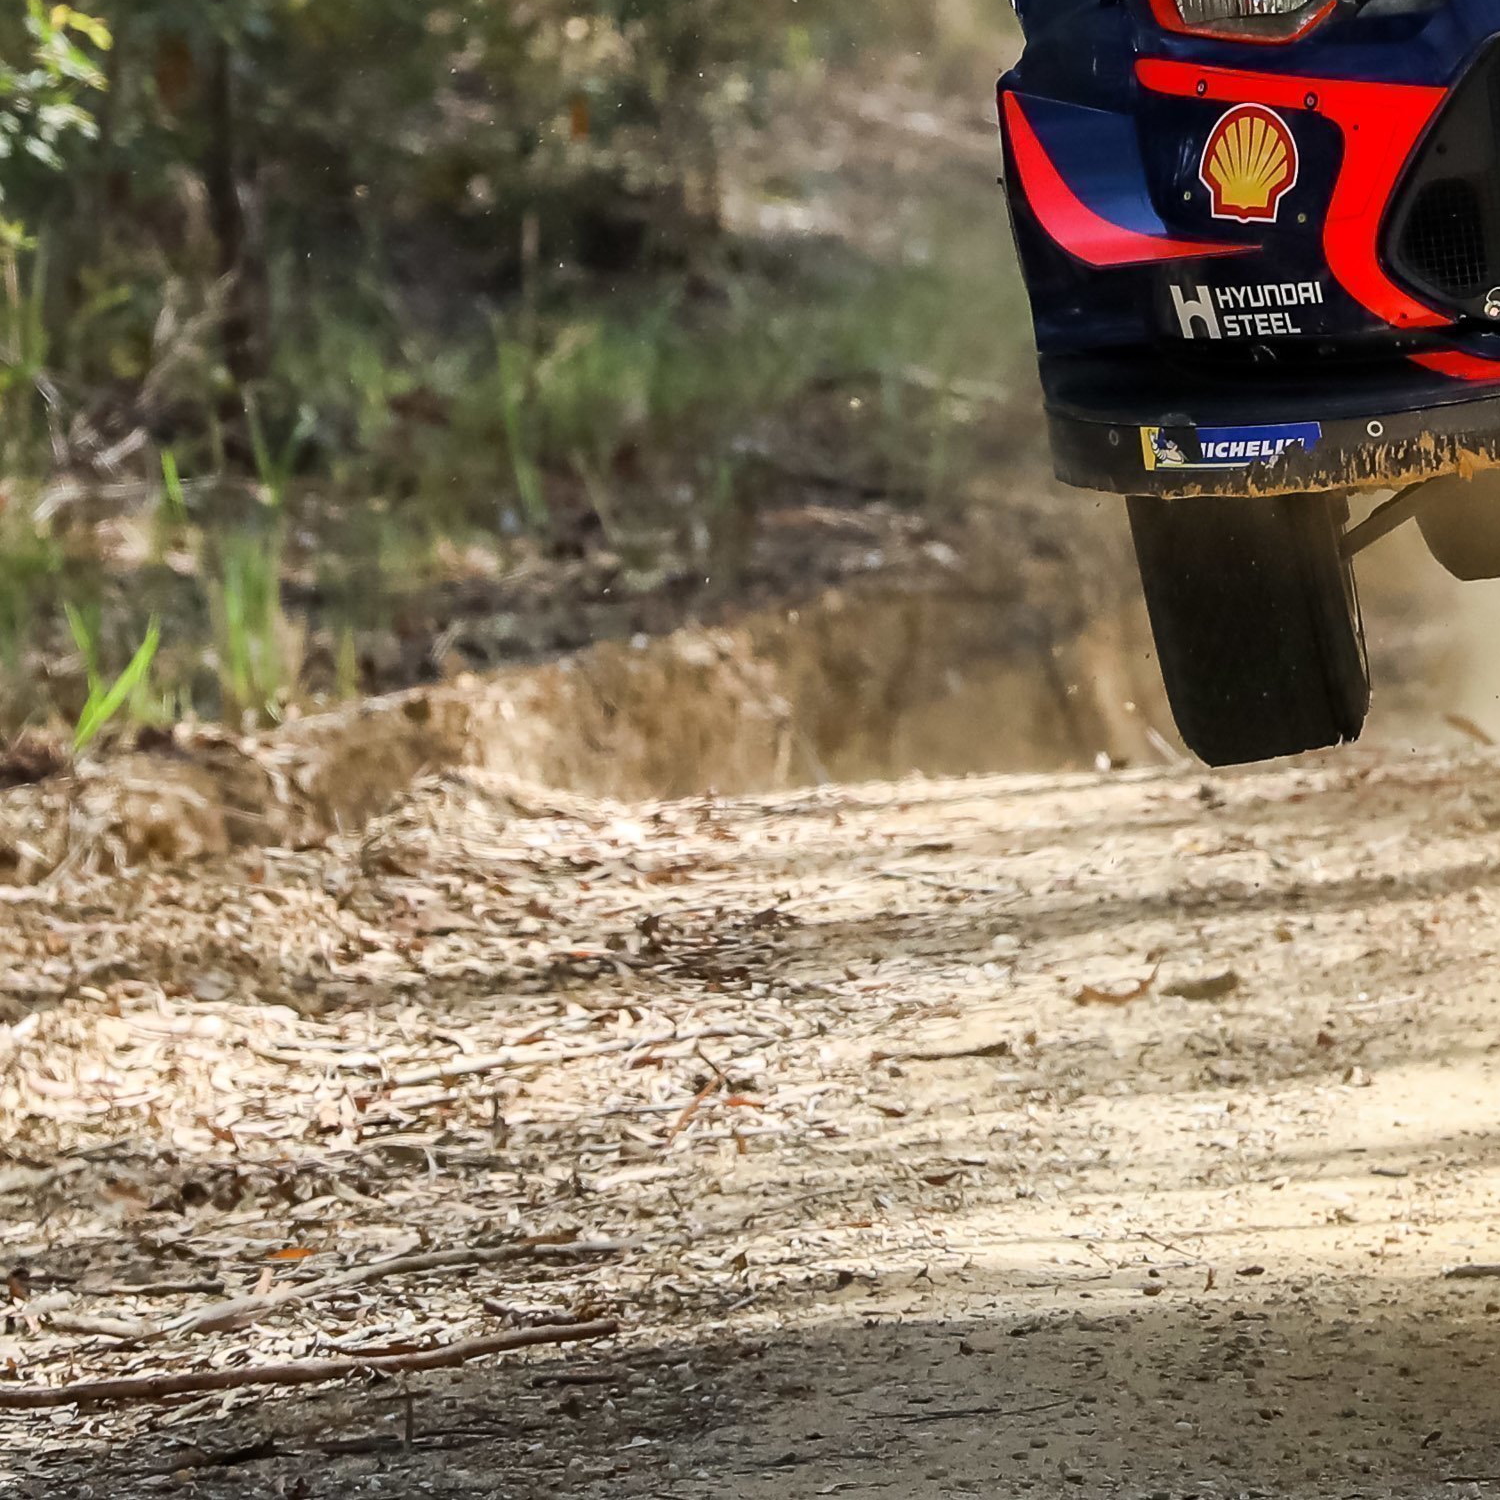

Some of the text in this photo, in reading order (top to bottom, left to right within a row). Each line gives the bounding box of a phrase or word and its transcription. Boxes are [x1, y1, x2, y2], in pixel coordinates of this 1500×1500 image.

[1215, 281, 1325, 309] HYUNDAI
[1223, 312, 1302, 338] STEEL
[1200, 436, 1305, 460] ICHELI
